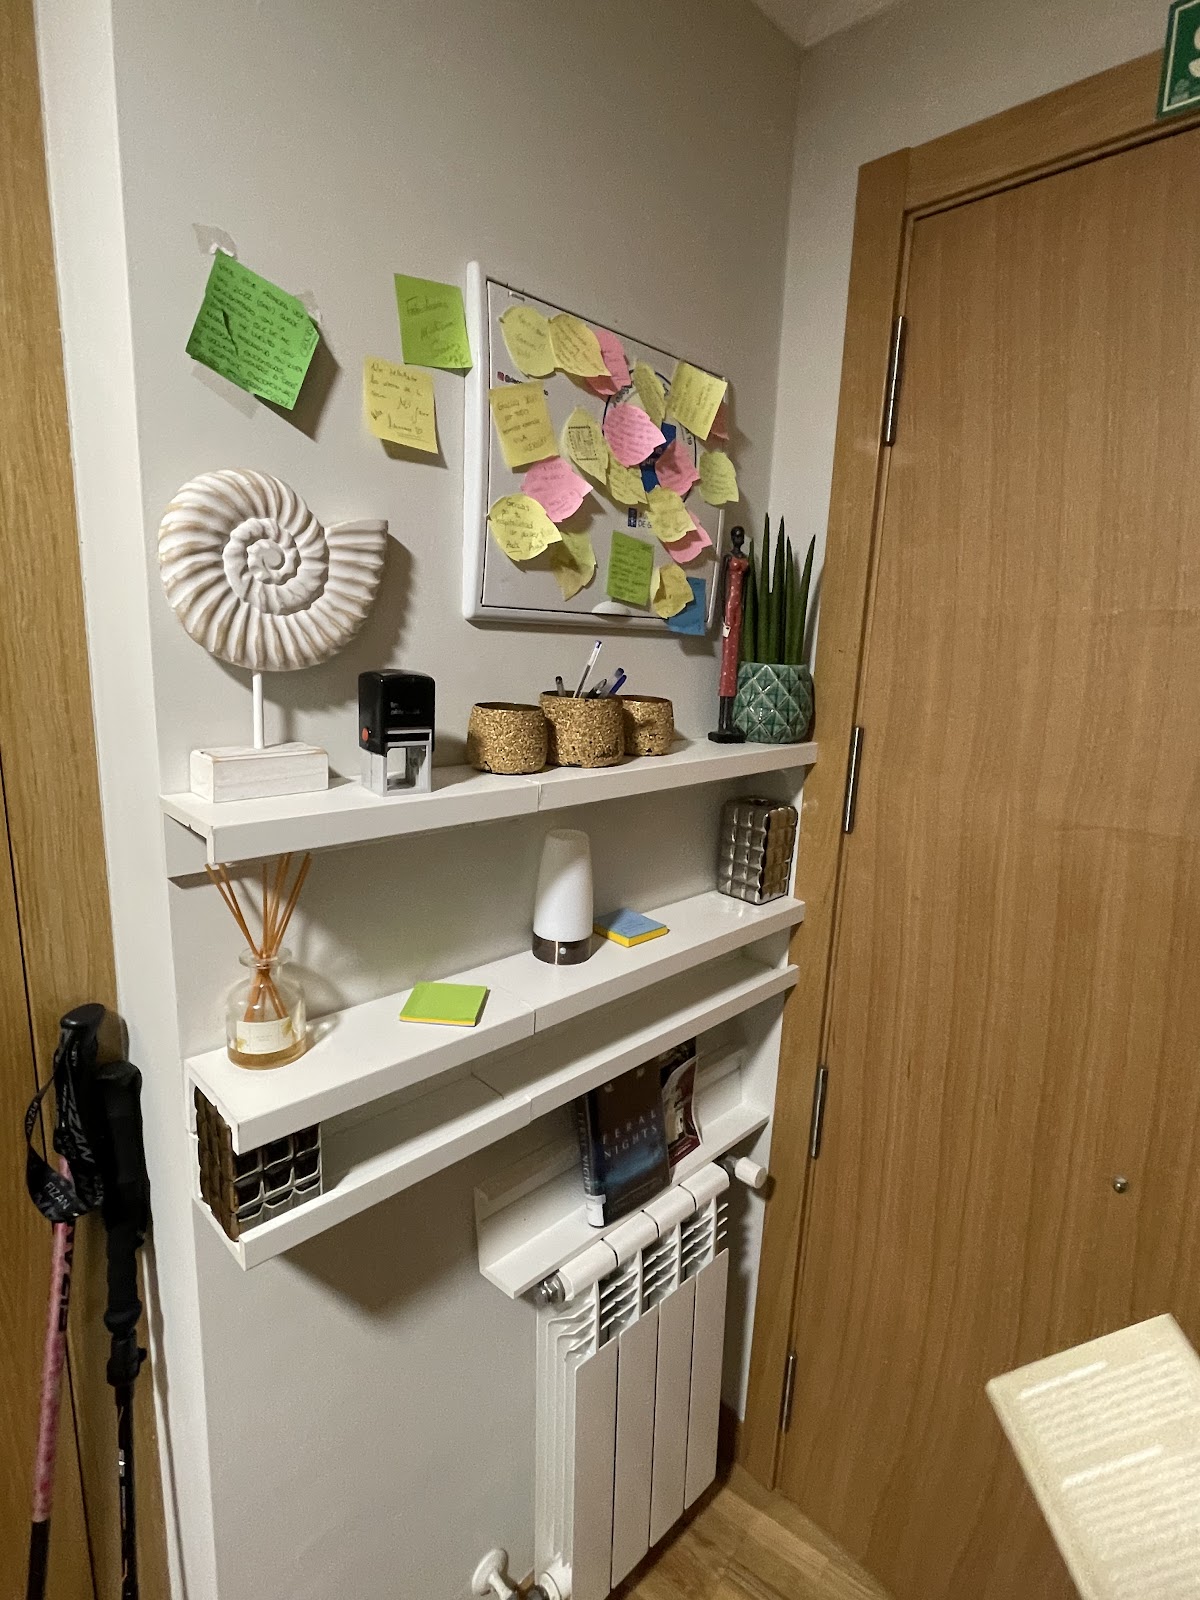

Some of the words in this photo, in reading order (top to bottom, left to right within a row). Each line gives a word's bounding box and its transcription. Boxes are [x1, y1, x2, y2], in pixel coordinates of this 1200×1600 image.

[602, 1110, 656, 1144] FERAL
[604, 1126, 657, 1157] NIGHTS
[44, 1181, 71, 1210] FIZAN
